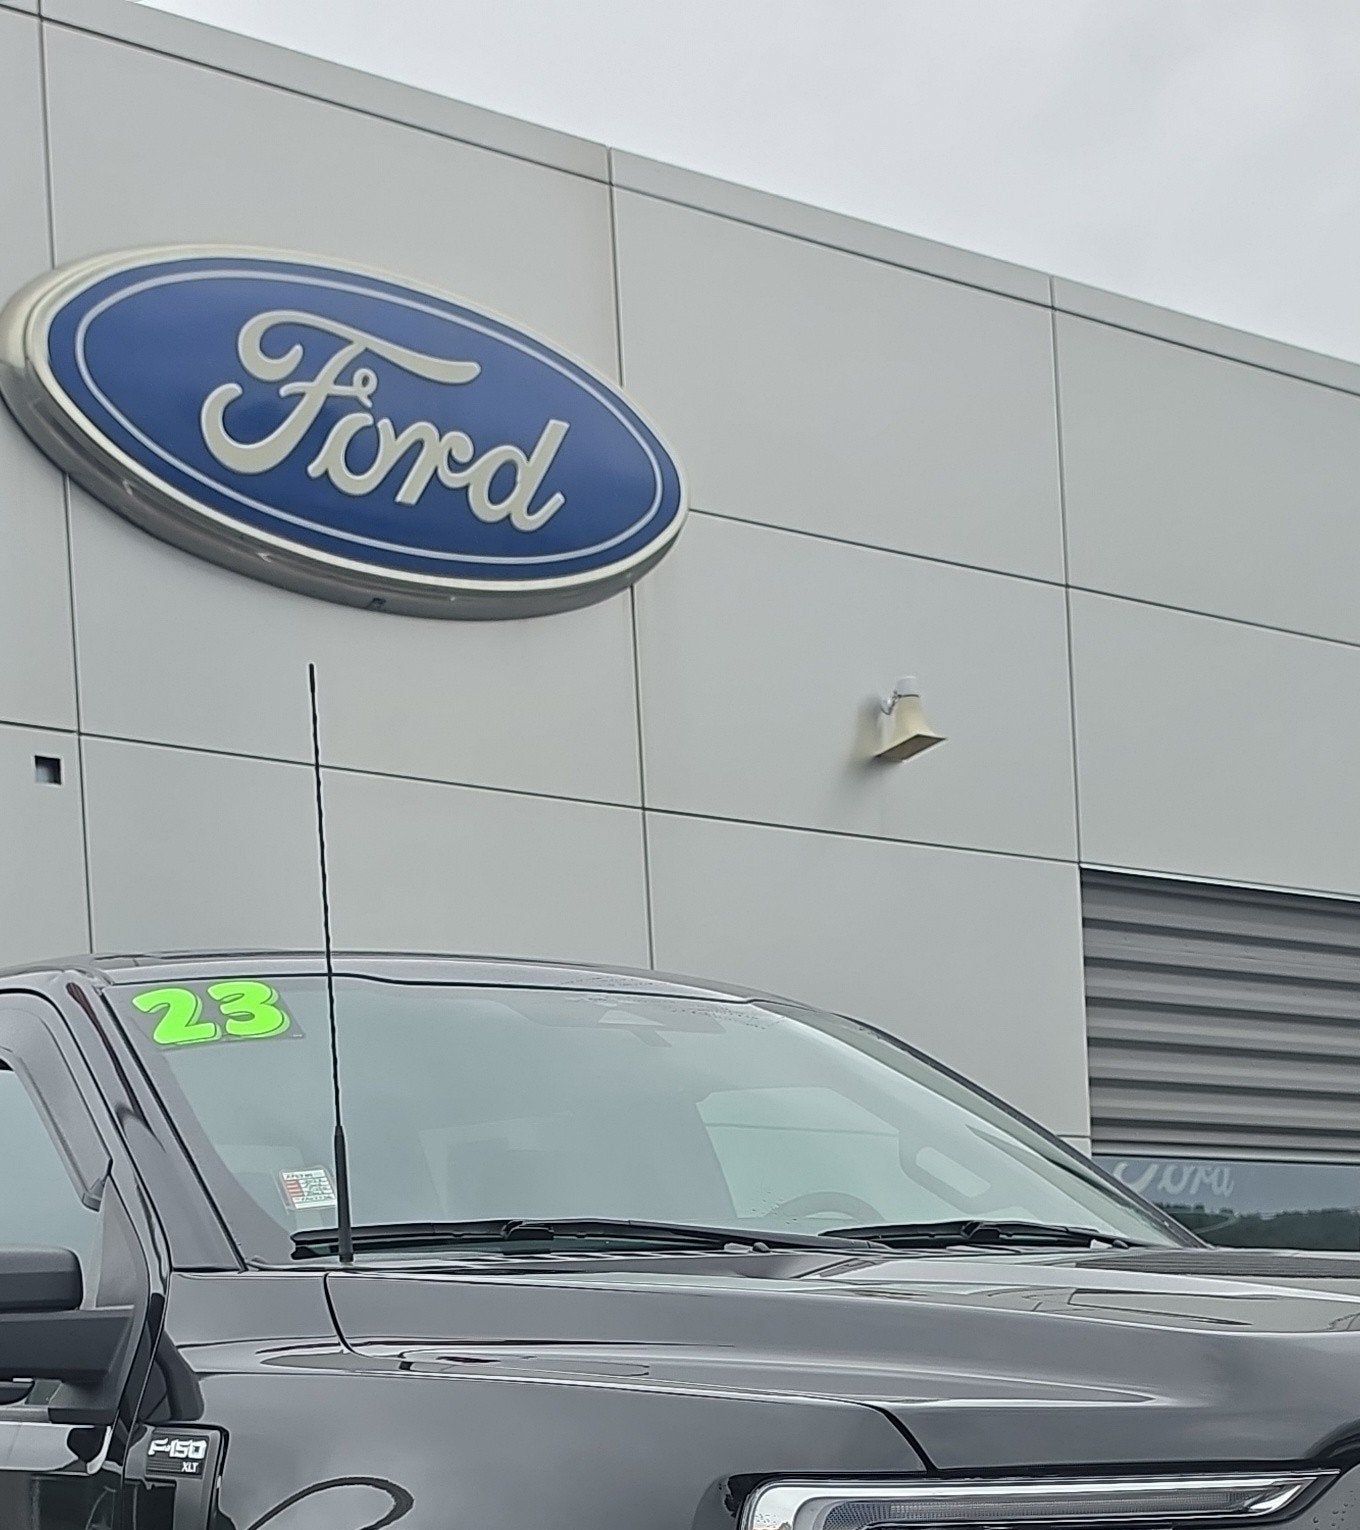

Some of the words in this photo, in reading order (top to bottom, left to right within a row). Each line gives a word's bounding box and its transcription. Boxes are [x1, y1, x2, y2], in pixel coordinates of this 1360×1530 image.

[201, 309, 570, 532] Ford
[131, 980, 290, 1046] 23
[148, 1438, 207, 1459] F-150
[181, 1461, 199, 1472] XLT
